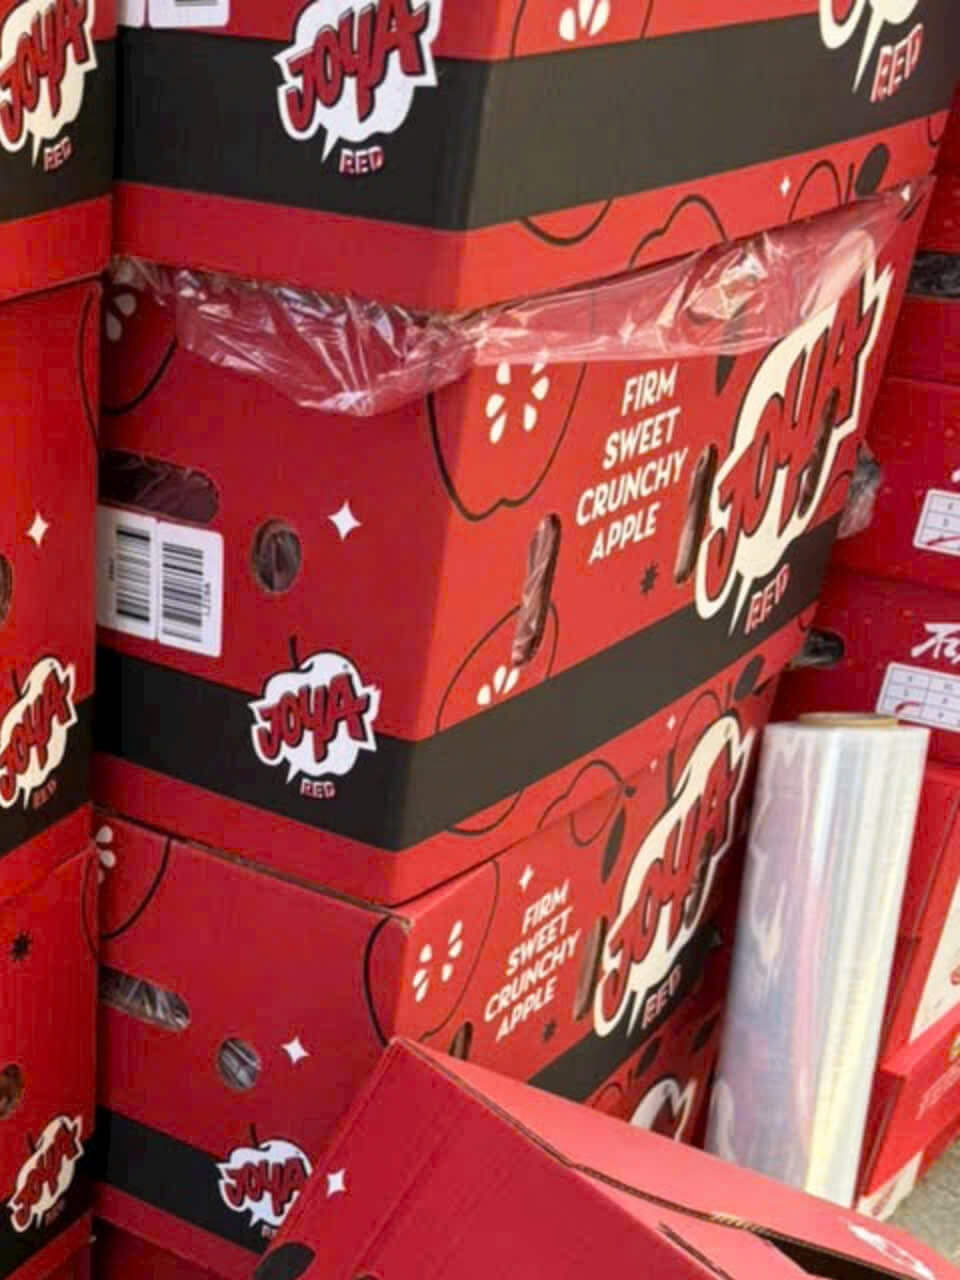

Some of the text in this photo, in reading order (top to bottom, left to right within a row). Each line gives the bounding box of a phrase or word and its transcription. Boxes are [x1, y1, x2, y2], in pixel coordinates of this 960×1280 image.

[870, 23, 924, 103] RED
[339, 145, 385, 176] RED
[621, 361, 679, 417] FIRM
[602, 406, 681, 470] SWEET
[576, 447, 689, 526] CRUNCHY
[588, 502, 661, 566] APPLE
[745, 562, 790, 636] RED
[257, 672, 372, 765] JOYA
[299, 777, 336, 799] RED
[506, 906, 574, 976] SWEET
[522, 879, 571, 935] FIRM
[484, 927, 582, 1023] CRUNCHY
[496, 975, 557, 1043] APPLE
